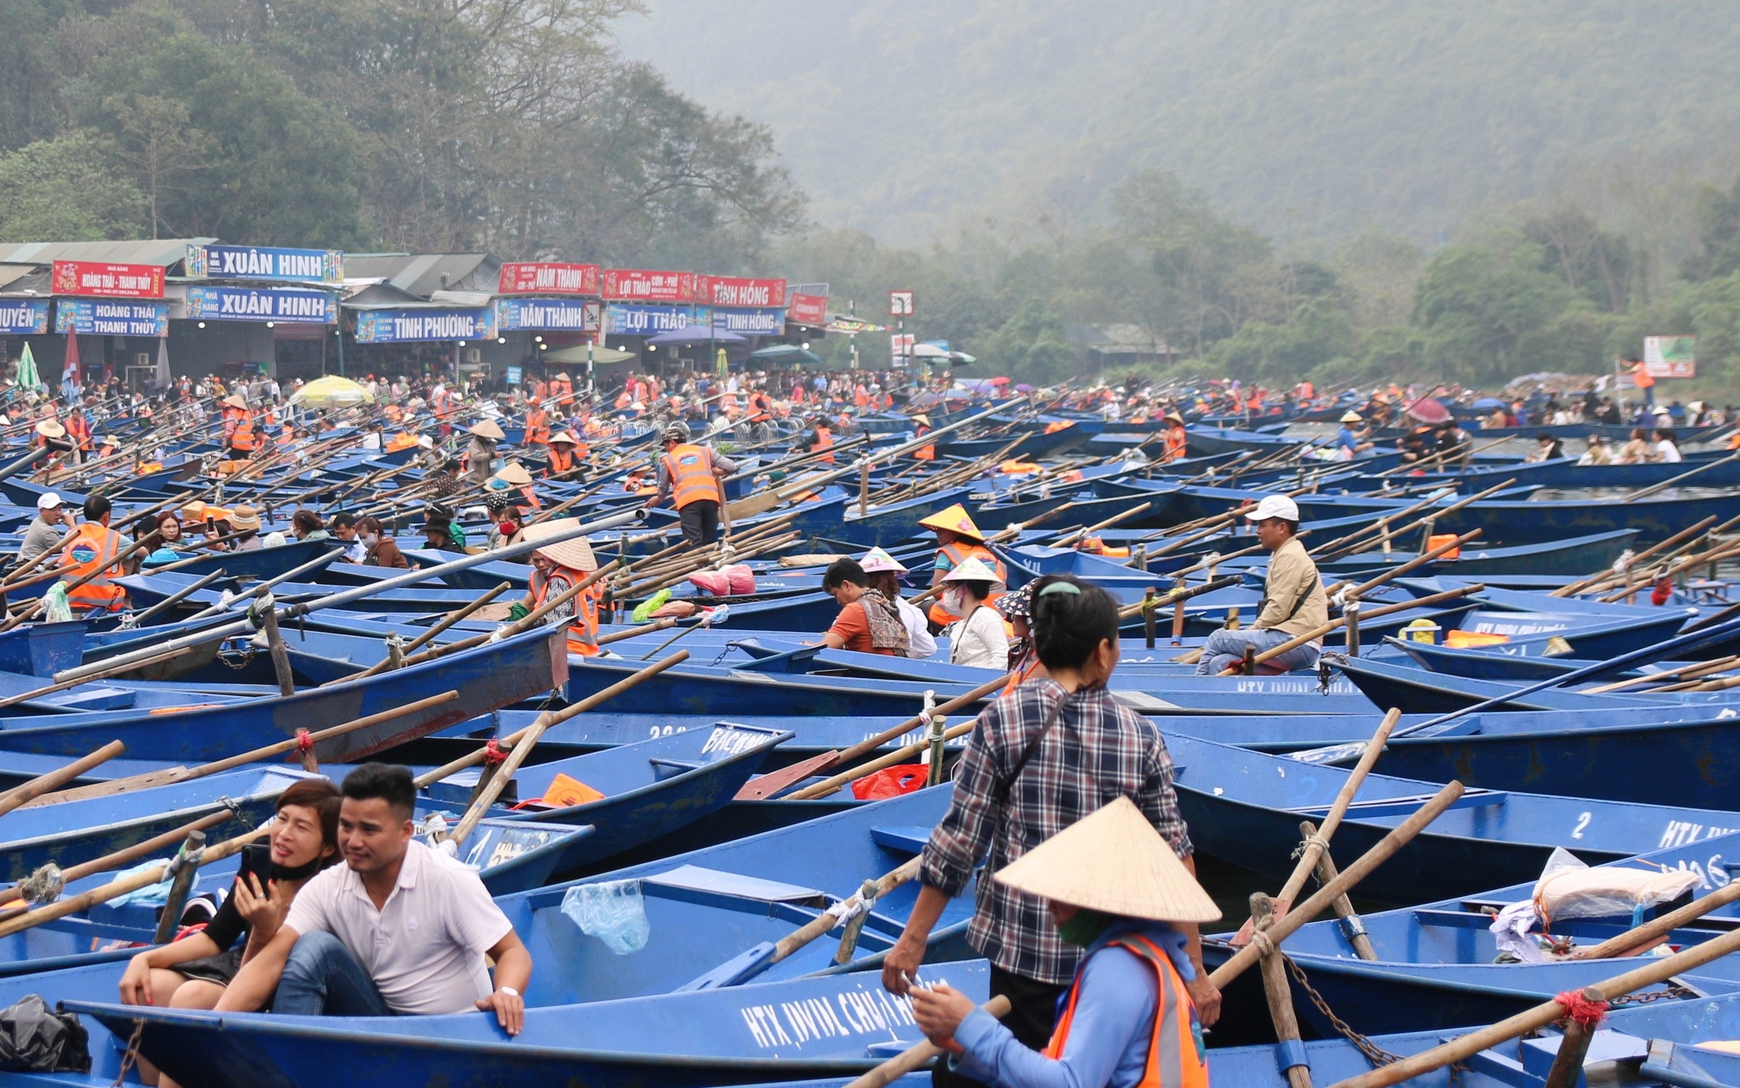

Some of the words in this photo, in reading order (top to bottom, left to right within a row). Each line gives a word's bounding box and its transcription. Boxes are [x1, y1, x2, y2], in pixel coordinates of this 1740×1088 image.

[224, 249, 273, 274] XUÂN
[279, 254, 321, 276] HINH
[96, 303, 131, 318] HOÀNG
[133, 304, 155, 319] THÁI
[221, 291, 273, 315] XUÂN
[279, 297, 325, 316] HINH
[520, 302, 545, 327] NĂM
[545, 302, 582, 327] THÀNH
[94, 321, 128, 334] THANH
[130, 319, 156, 334] THỦY
[394, 313, 423, 339] TÍNH
[424, 314, 474, 339] PHƯƠNG
[626, 310, 648, 332] LỢI
[509, 372, 521, 380] WC
[1571, 811, 1592, 840] 2
[740, 1004, 792, 1048] HTX
